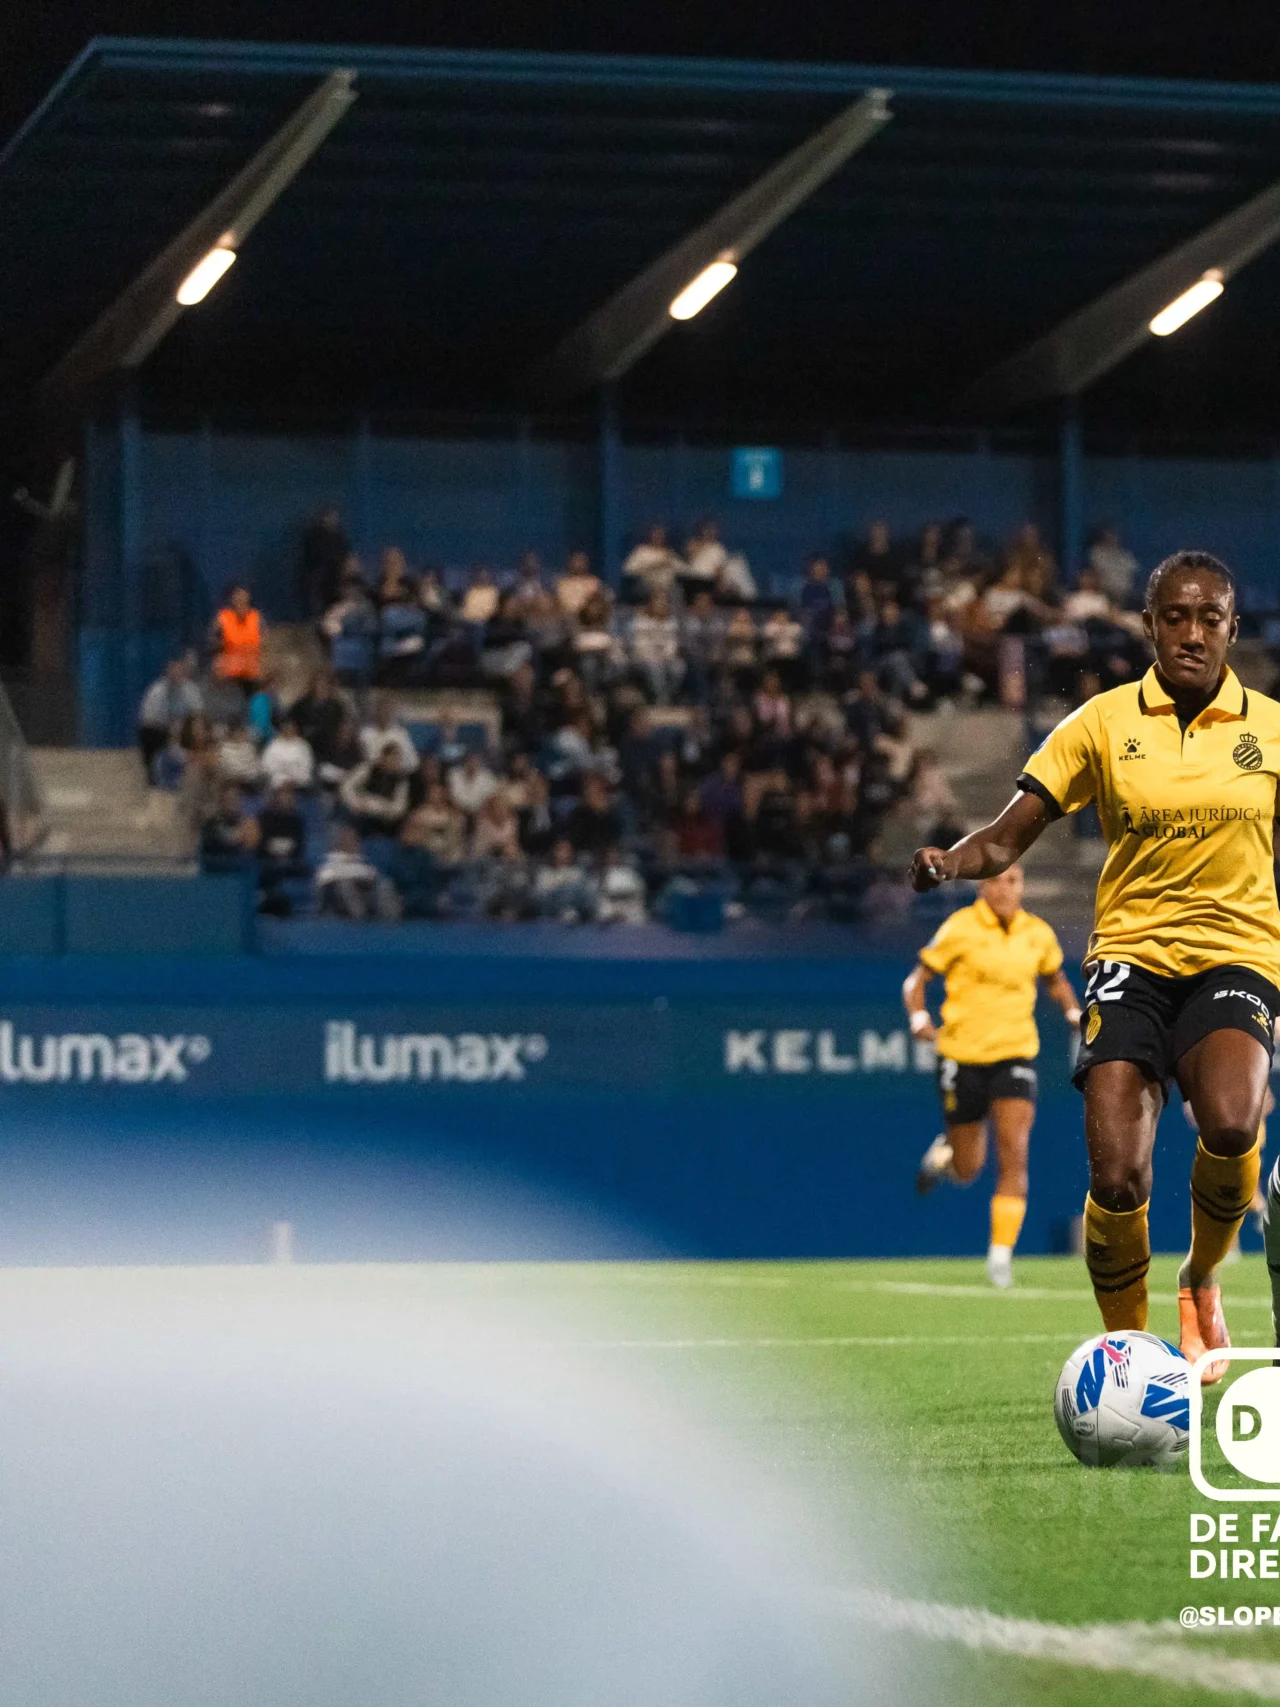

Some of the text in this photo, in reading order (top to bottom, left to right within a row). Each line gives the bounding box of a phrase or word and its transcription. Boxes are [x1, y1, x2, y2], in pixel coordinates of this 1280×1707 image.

[1118, 753, 1147, 762] KELME
[1187, 804, 1261, 825] JURÍDICA
[0, 1020, 189, 1083] lumax
